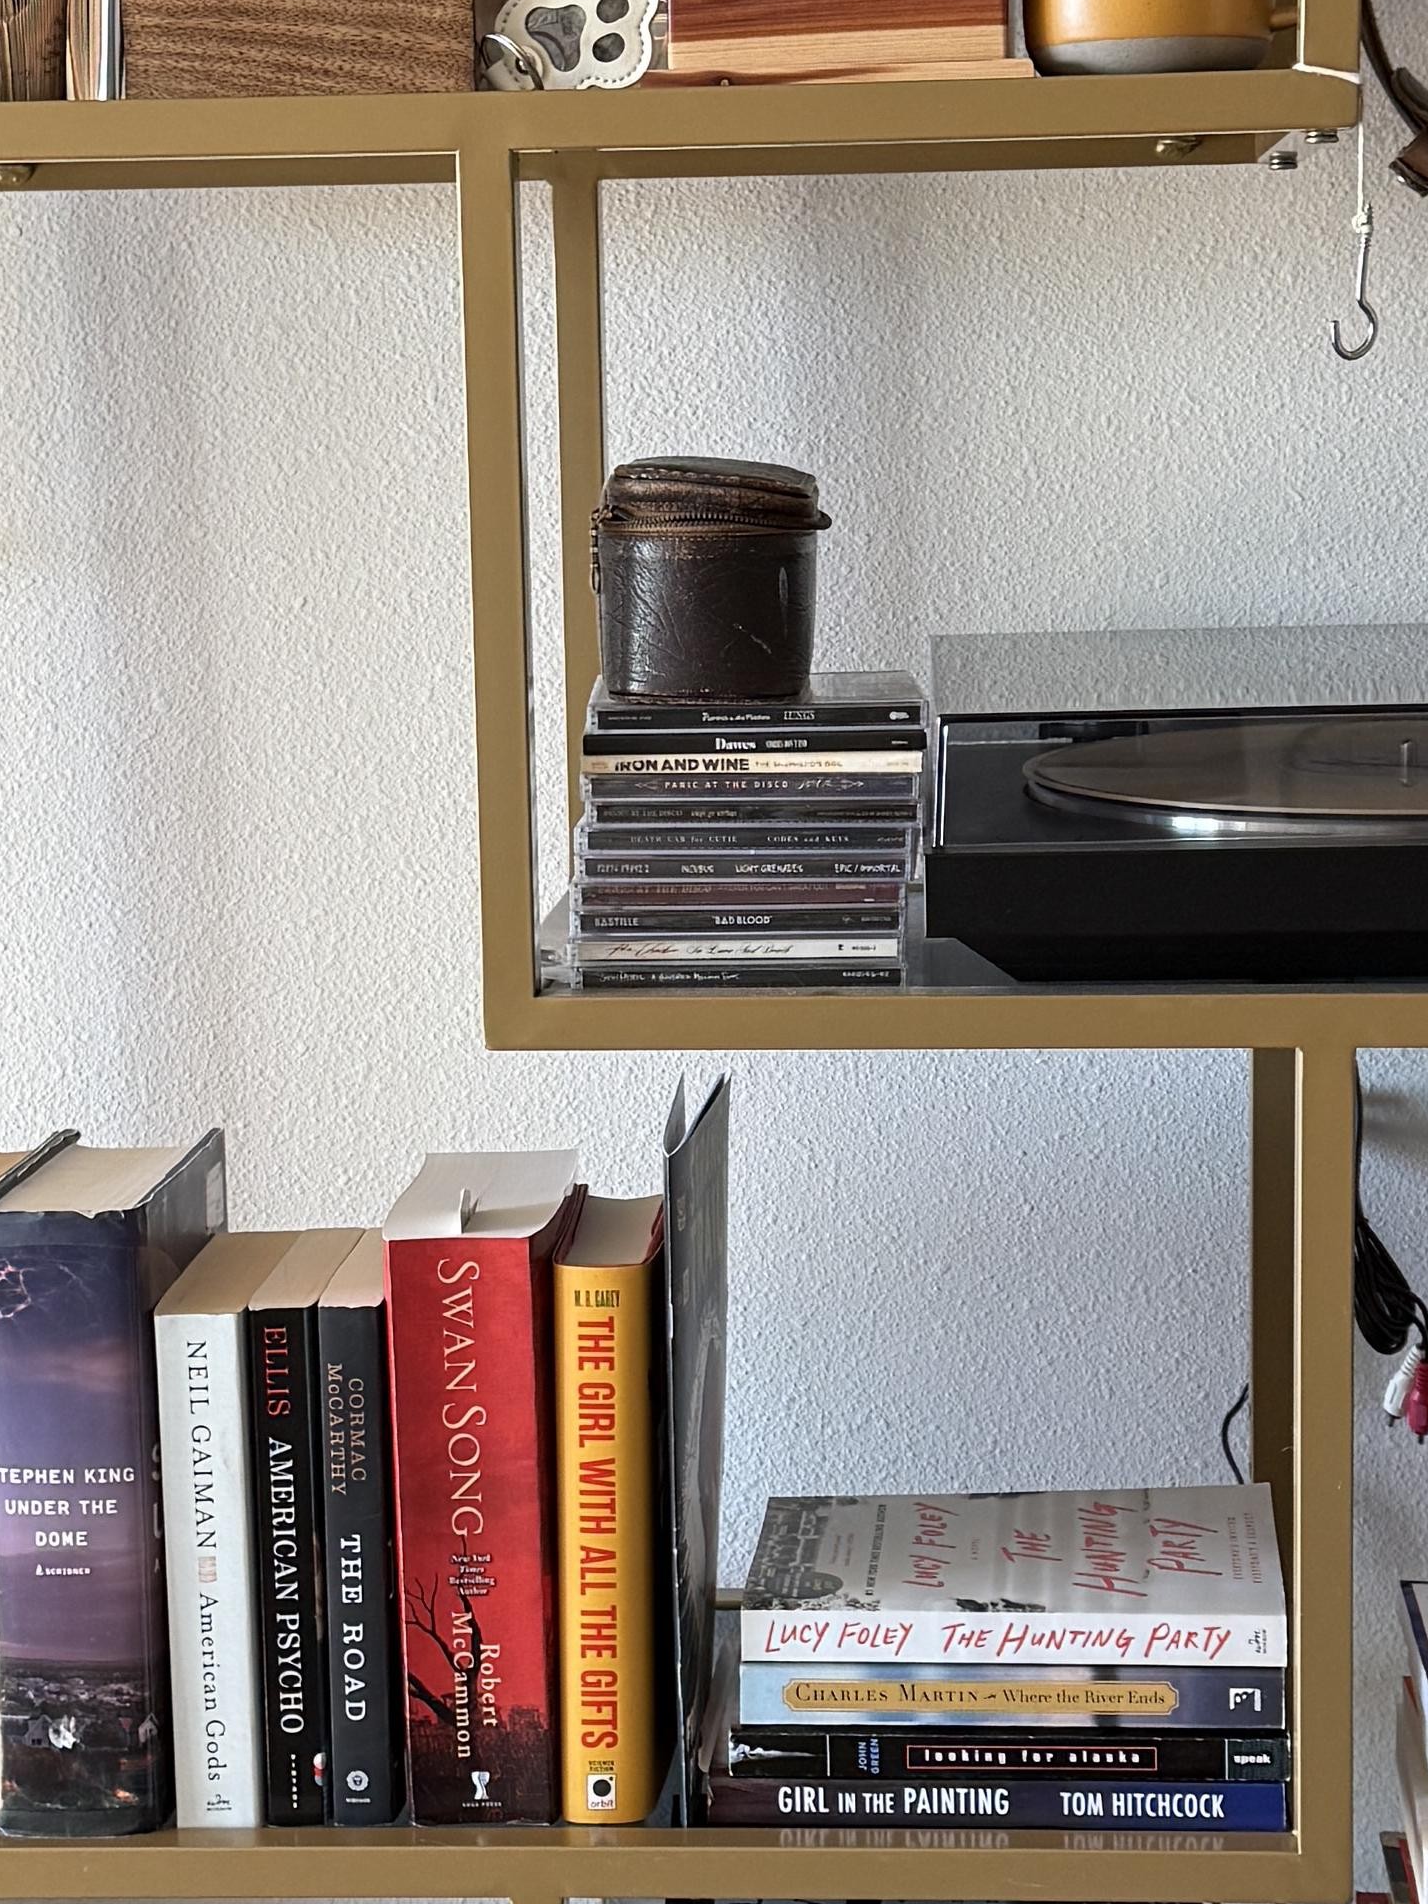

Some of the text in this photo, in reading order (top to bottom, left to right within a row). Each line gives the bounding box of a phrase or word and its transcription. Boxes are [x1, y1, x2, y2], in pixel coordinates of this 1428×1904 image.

[615, 760, 657, 771] IRON
[661, 759, 699, 771] AND
[703, 758, 750, 770] WINE
[438, 1258, 486, 1540] SWAN SONG
[84, 1466, 135, 1484] KING
[5, 1498, 117, 1516] UNDER THE
[35, 1530, 88, 1547] DOME
[577, 1315, 618, 1749] THE GIRL WITH ALL THE GIFTS
[187, 1340, 227, 1781] NEIL GAIMAN American Gods
[340, 1534, 367, 1722] THE ROAD
[765, 1619, 1231, 1660] LUCY FOLEY THE HUNTING PARTY
[778, 1787, 1010, 1815] GIRL IN THE PAINTING
[1060, 1791, 1224, 1818] TOM HITCHCOCK
